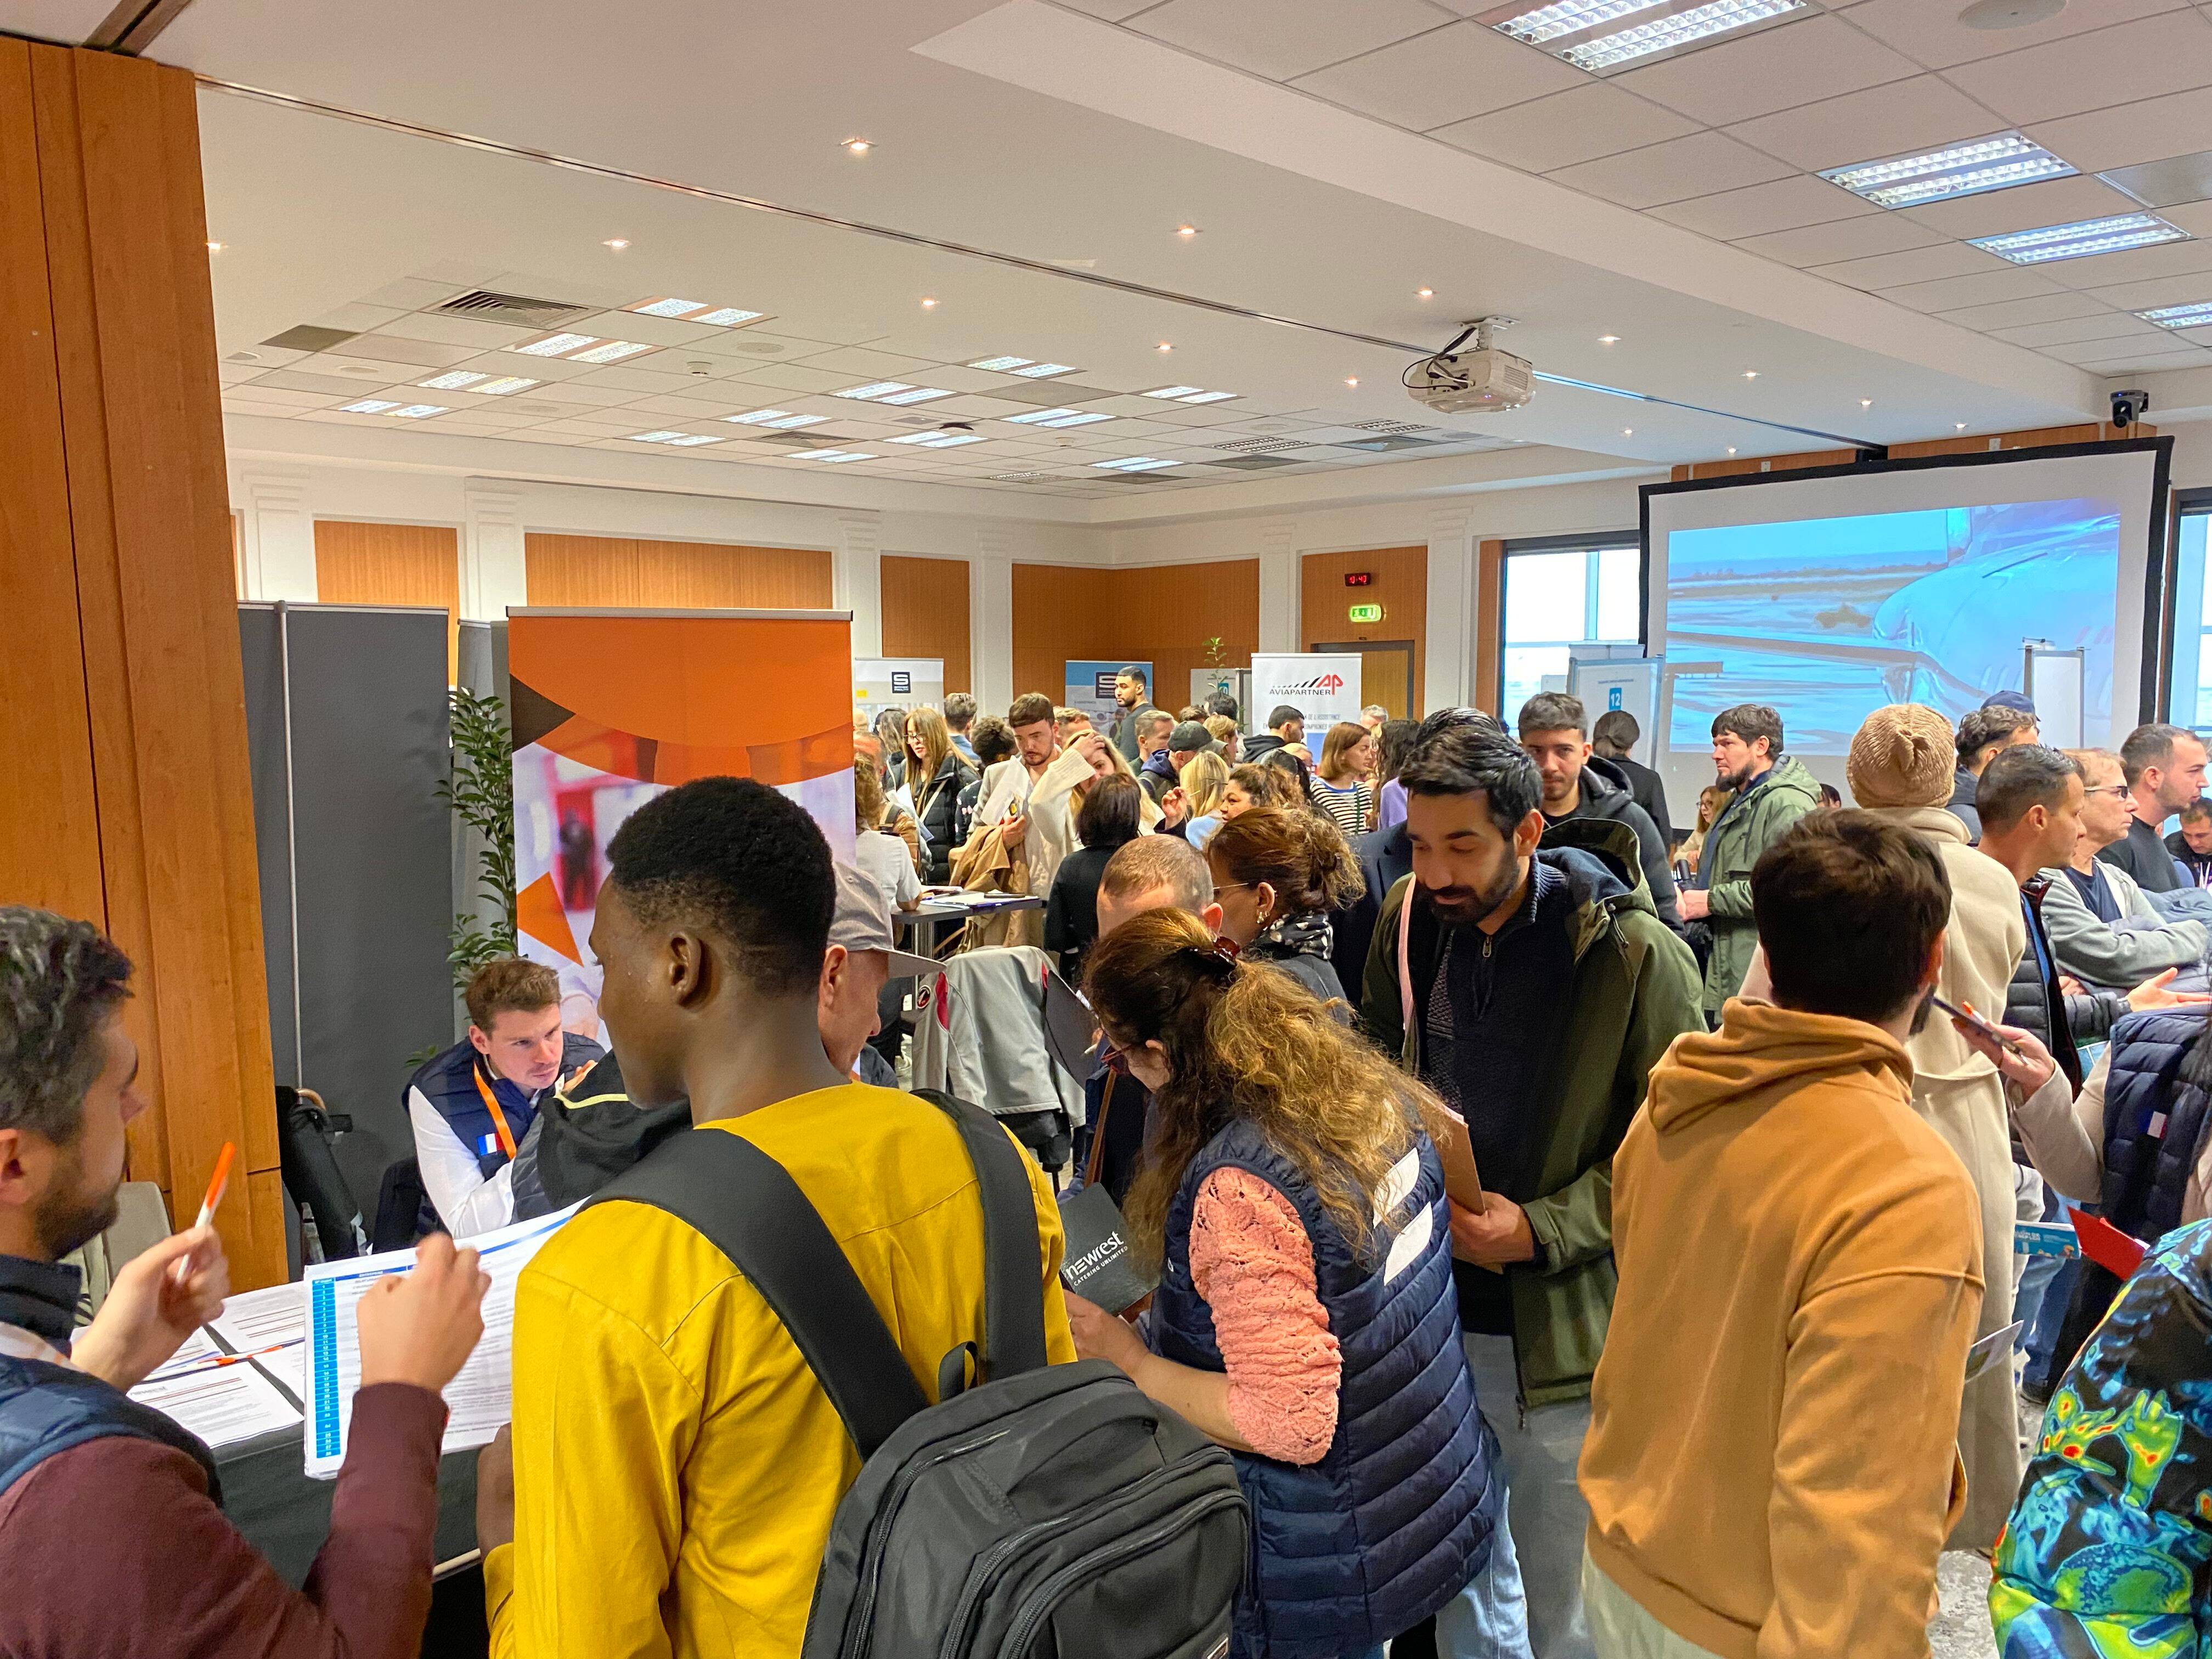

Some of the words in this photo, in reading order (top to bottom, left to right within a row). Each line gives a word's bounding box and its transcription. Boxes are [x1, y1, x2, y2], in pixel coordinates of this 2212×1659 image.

[1611, 693, 1621, 707] 12
[1074, 1265, 1100, 1286] CATERING
[1100, 1245, 1128, 1267] UNLIMITED
